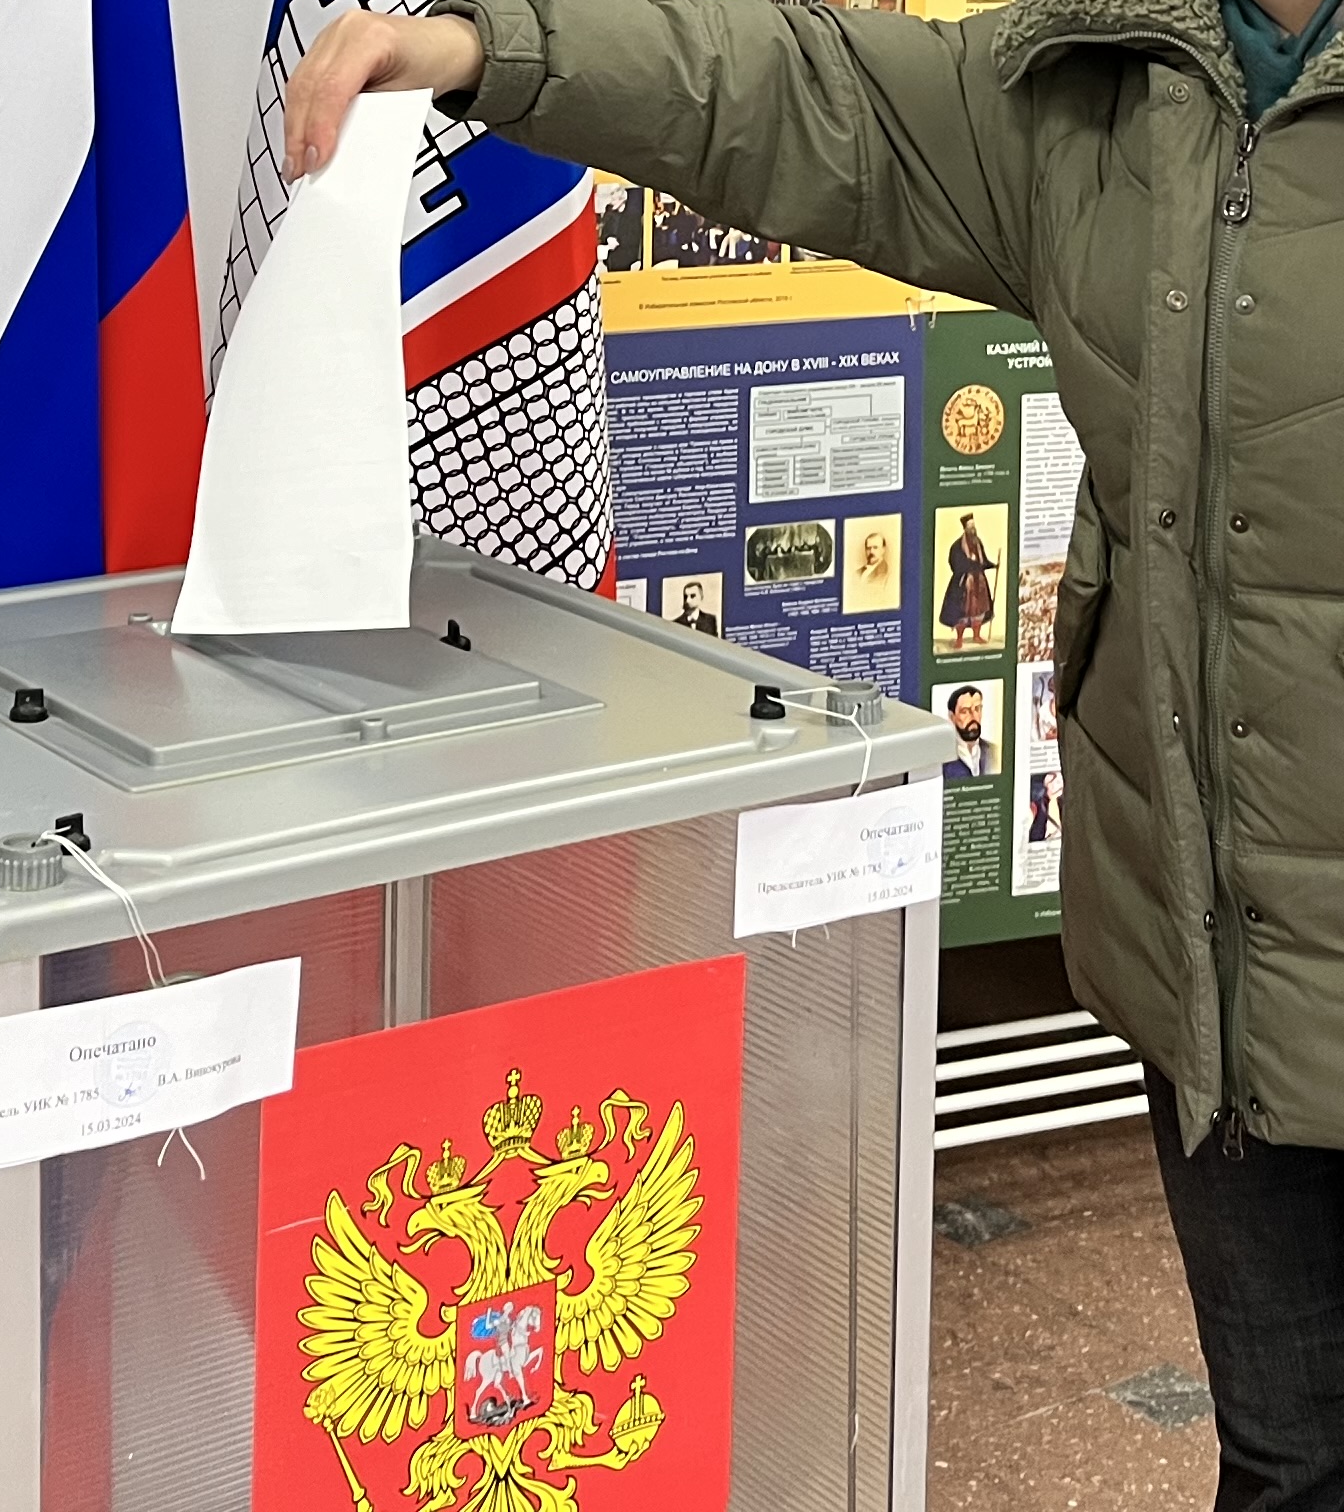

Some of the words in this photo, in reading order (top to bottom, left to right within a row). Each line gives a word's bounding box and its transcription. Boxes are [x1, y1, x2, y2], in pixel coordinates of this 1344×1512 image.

[986, 339, 1041, 356] КАЗАЧИЙ
[610, 362, 732, 385] САМОУПРАВЛЕНИЕ
[733, 360, 753, 376] НА
[753, 359, 789, 377] ДОНУ
[791, 358, 800, 372] В
[802, 356, 829, 371] XVIII
[838, 354, 859, 369] XIX
[860, 351, 900, 367] ВЕКАХ
[859, 820, 925, 842] Опечатано
[69, 1035, 158, 1063] Опечатано
[23, 1094, 53, 1115] УИК
[72, 1087, 101, 1106] 1785
[80, 1112, 142, 1138] 15.03.2024
